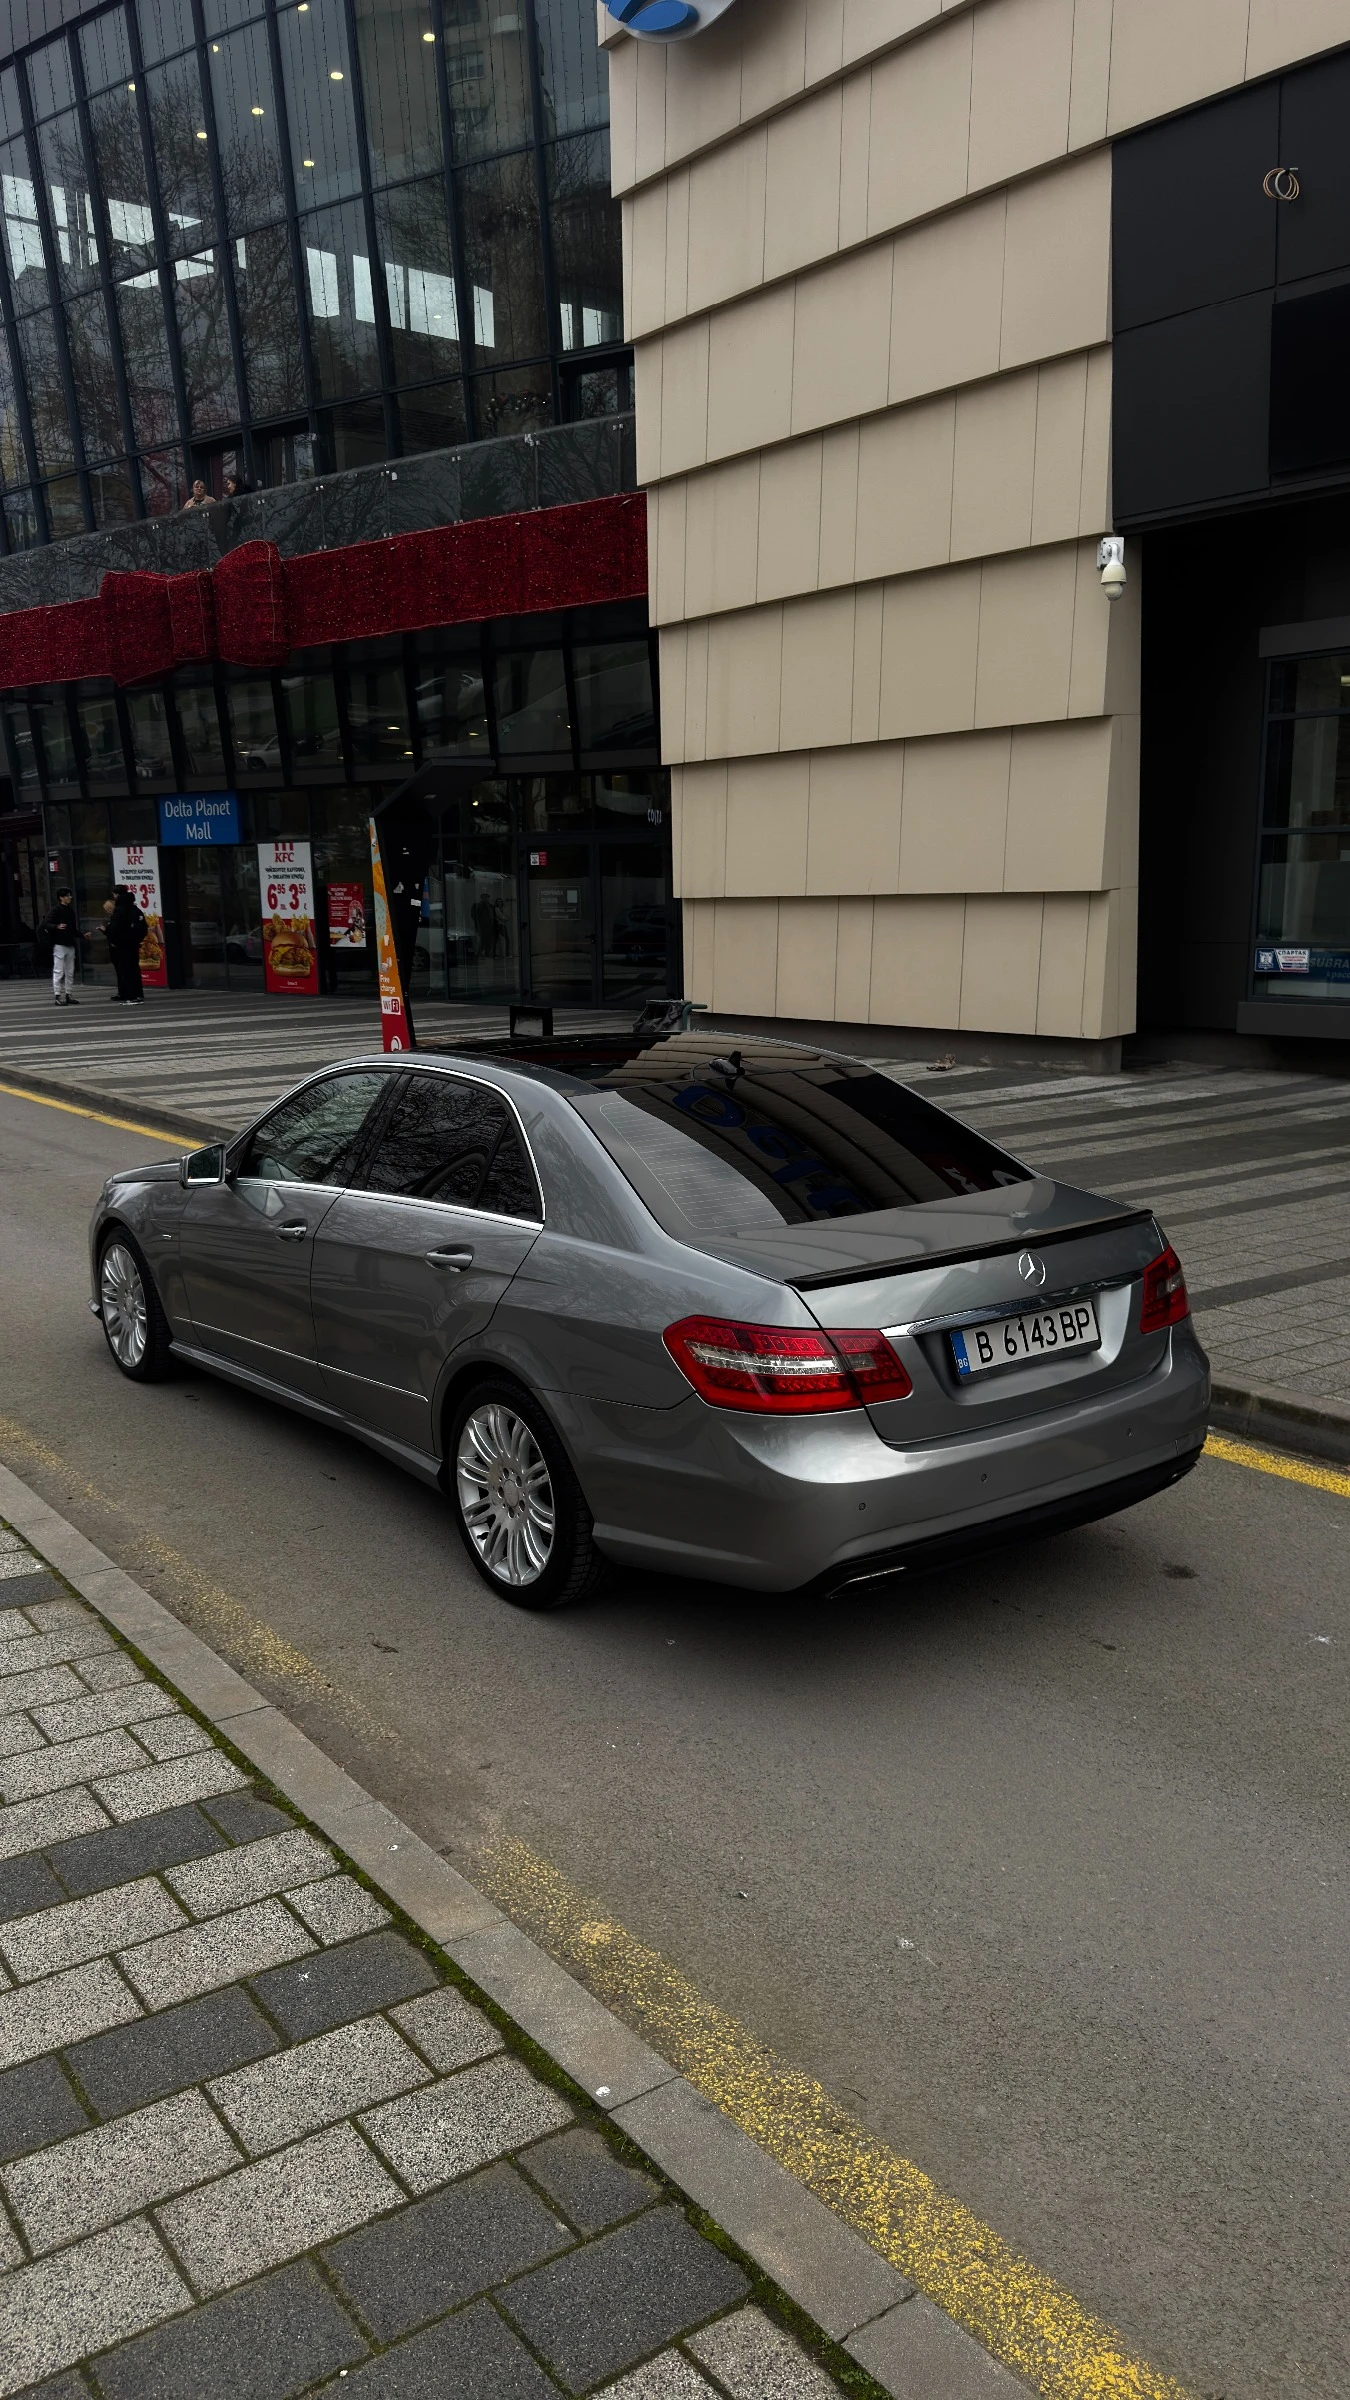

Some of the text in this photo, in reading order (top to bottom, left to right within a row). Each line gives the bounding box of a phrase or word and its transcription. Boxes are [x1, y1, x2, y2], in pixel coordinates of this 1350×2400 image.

[165, 798, 231, 818] Delta Planet
[186, 821, 212, 840] Mall
[127, 855, 144, 865] KFC
[274, 852, 295, 863] KFC
[379, 975, 390, 983] Free
[975, 1331, 994, 1364] B
[958, 1358, 969, 1369] BG
